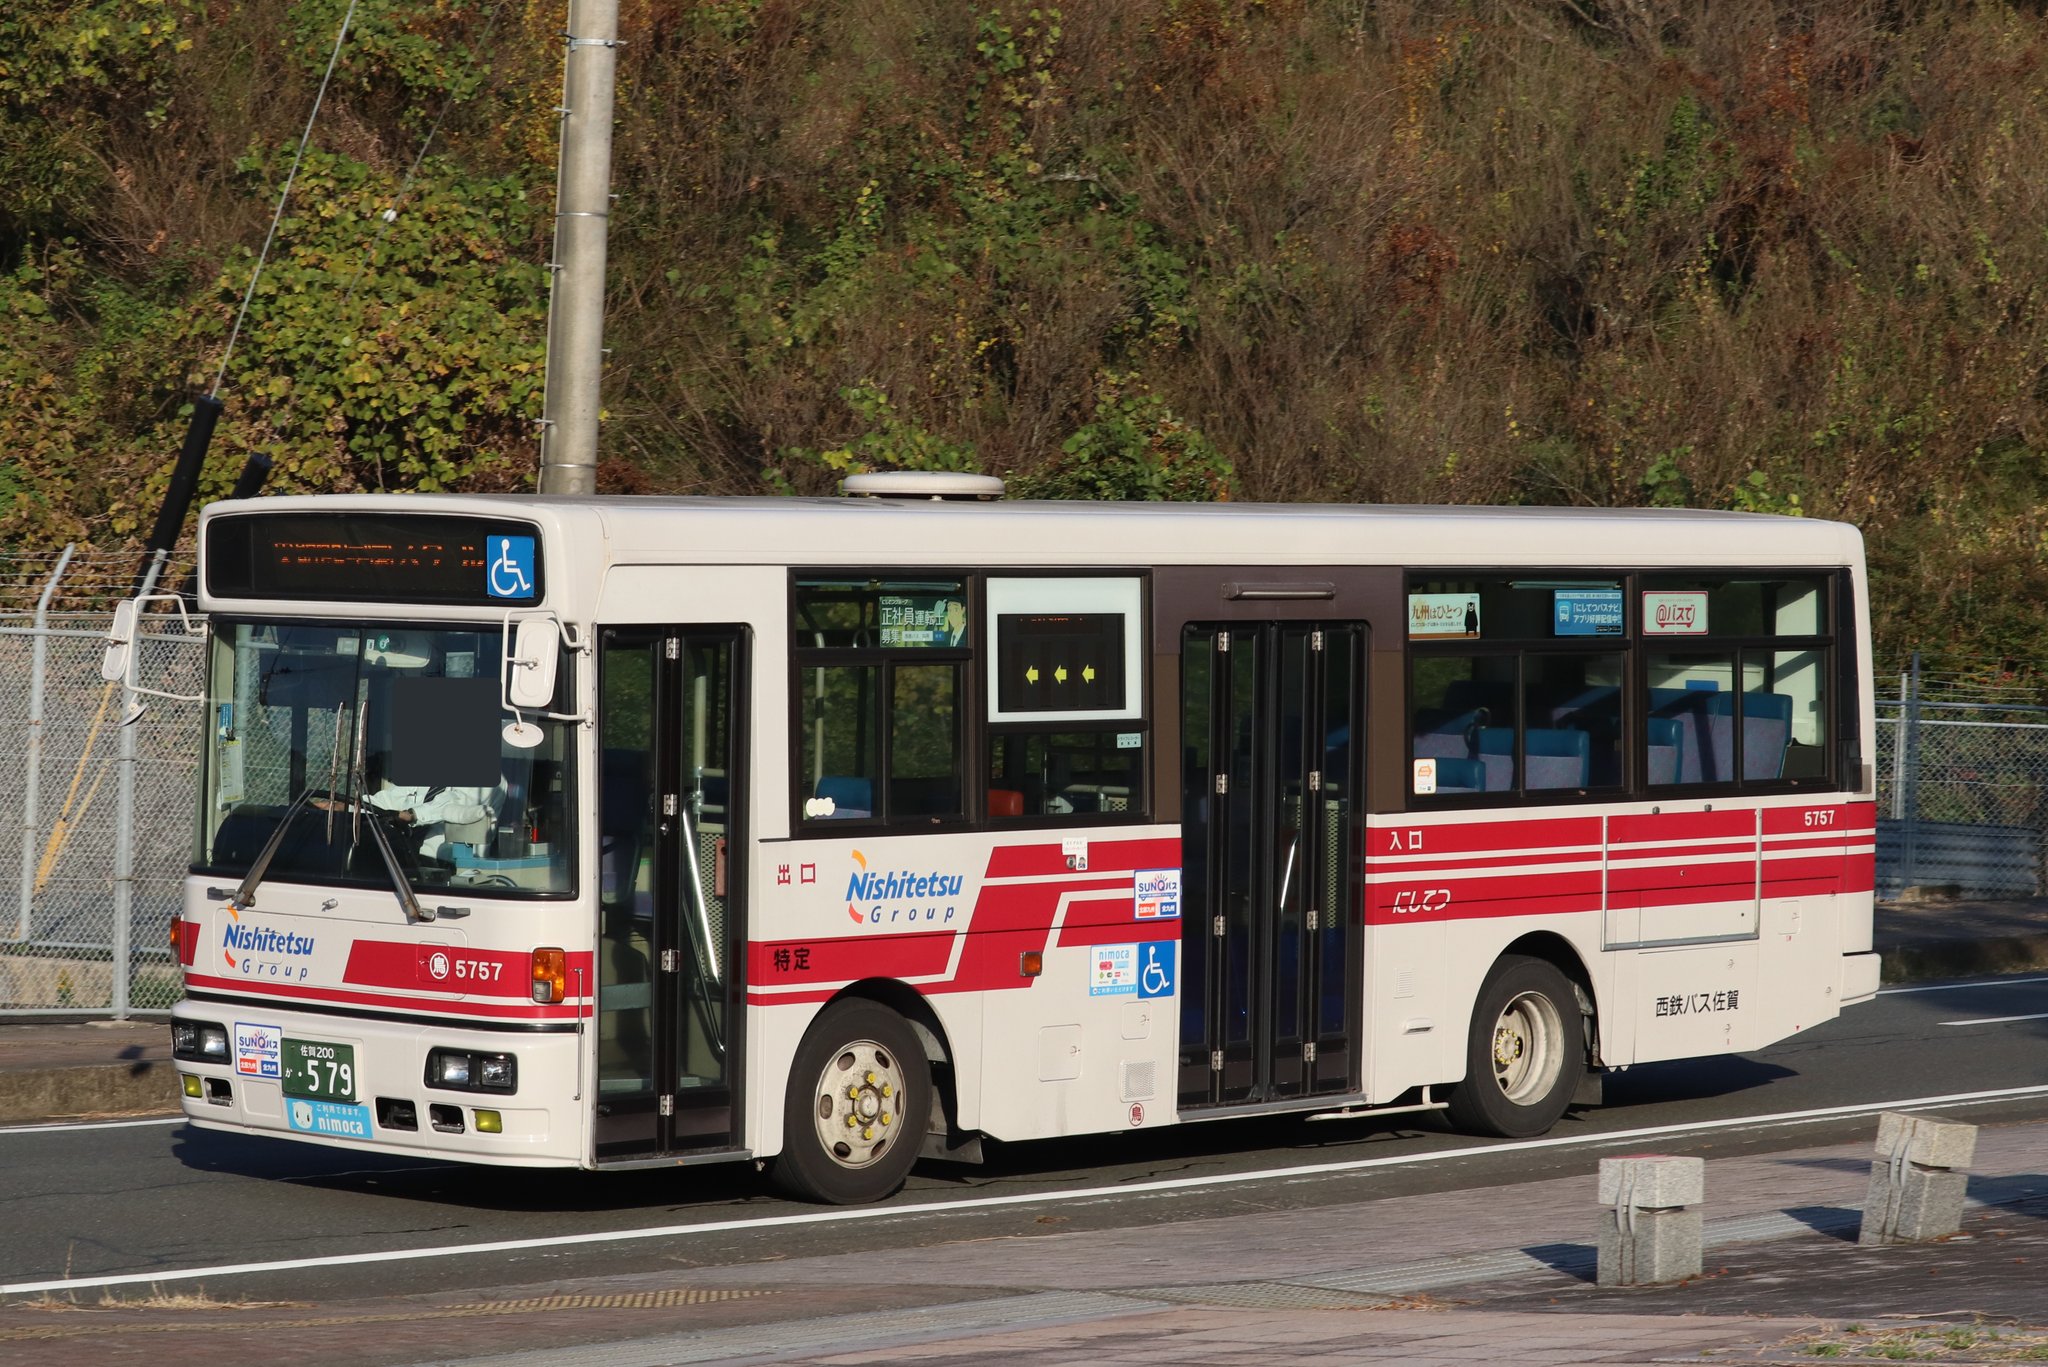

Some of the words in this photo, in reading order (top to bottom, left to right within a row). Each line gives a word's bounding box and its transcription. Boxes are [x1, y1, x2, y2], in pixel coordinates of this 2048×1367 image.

[881, 606, 944, 627] 正社員運転士
[1411, 604, 1463, 620] 九州はひとつ
[881, 628, 900, 644] 募集
[1804, 810, 1835, 826] 5757
[1389, 830, 1423, 850] 入口
[777, 863, 816, 885] 出口
[846, 871, 963, 901] Nishitetsu
[1393, 889, 1451, 914] にしてつ
[870, 905, 955, 924] Group
[223, 923, 315, 956] Nishitetsu
[774, 947, 811, 972] 特定
[1099, 949, 1130, 960] nimoca
[242, 958, 308, 981] Group
[455, 959, 503, 981] 5757
[1656, 990, 1739, 1017] 西鉄バス佐賀
[318, 1113, 364, 1135] nimoca
